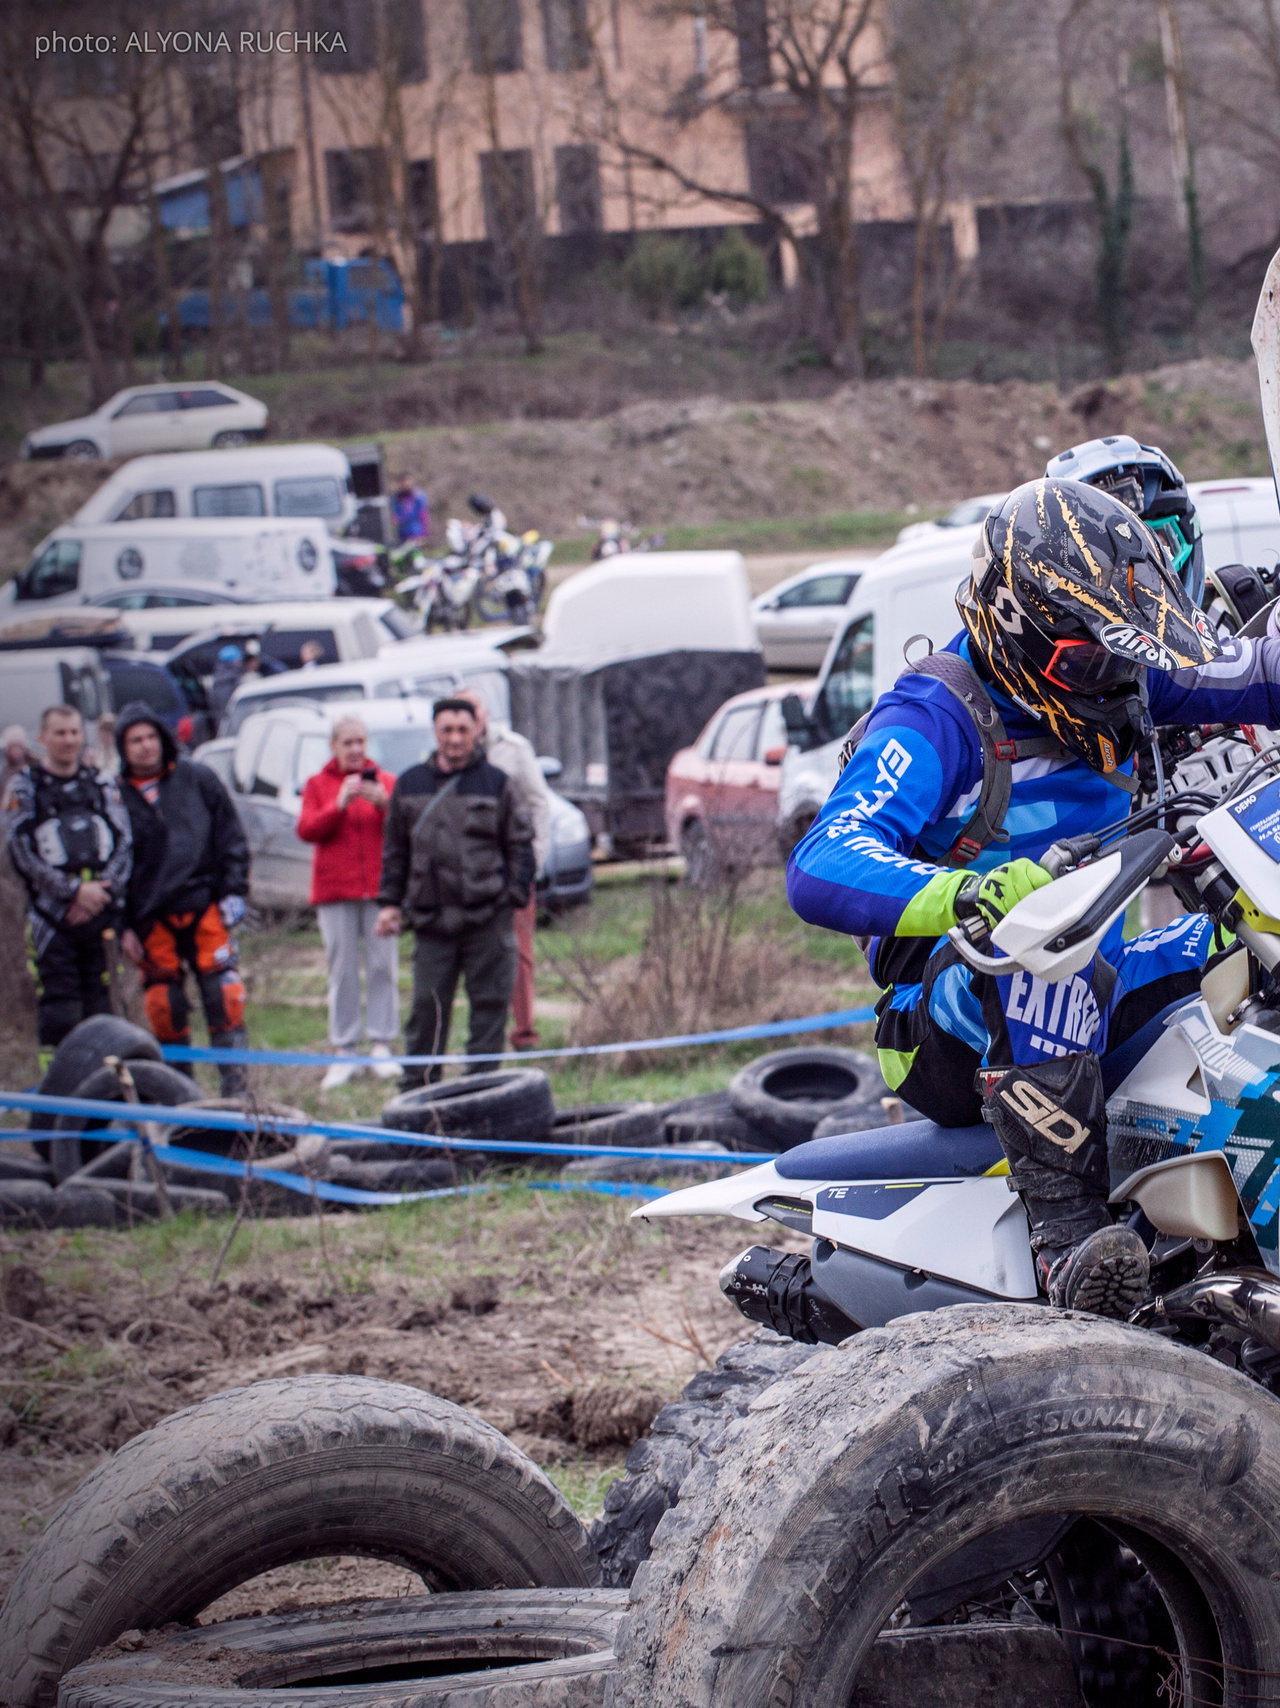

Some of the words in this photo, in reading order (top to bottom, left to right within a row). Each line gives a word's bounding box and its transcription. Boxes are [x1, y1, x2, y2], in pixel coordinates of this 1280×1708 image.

[1105, 628, 1172, 671] Airoh
[1102, 741, 1115, 767] Airoh
[1234, 794, 1257, 814] DEMO
[827, 1187, 849, 1199] TE
